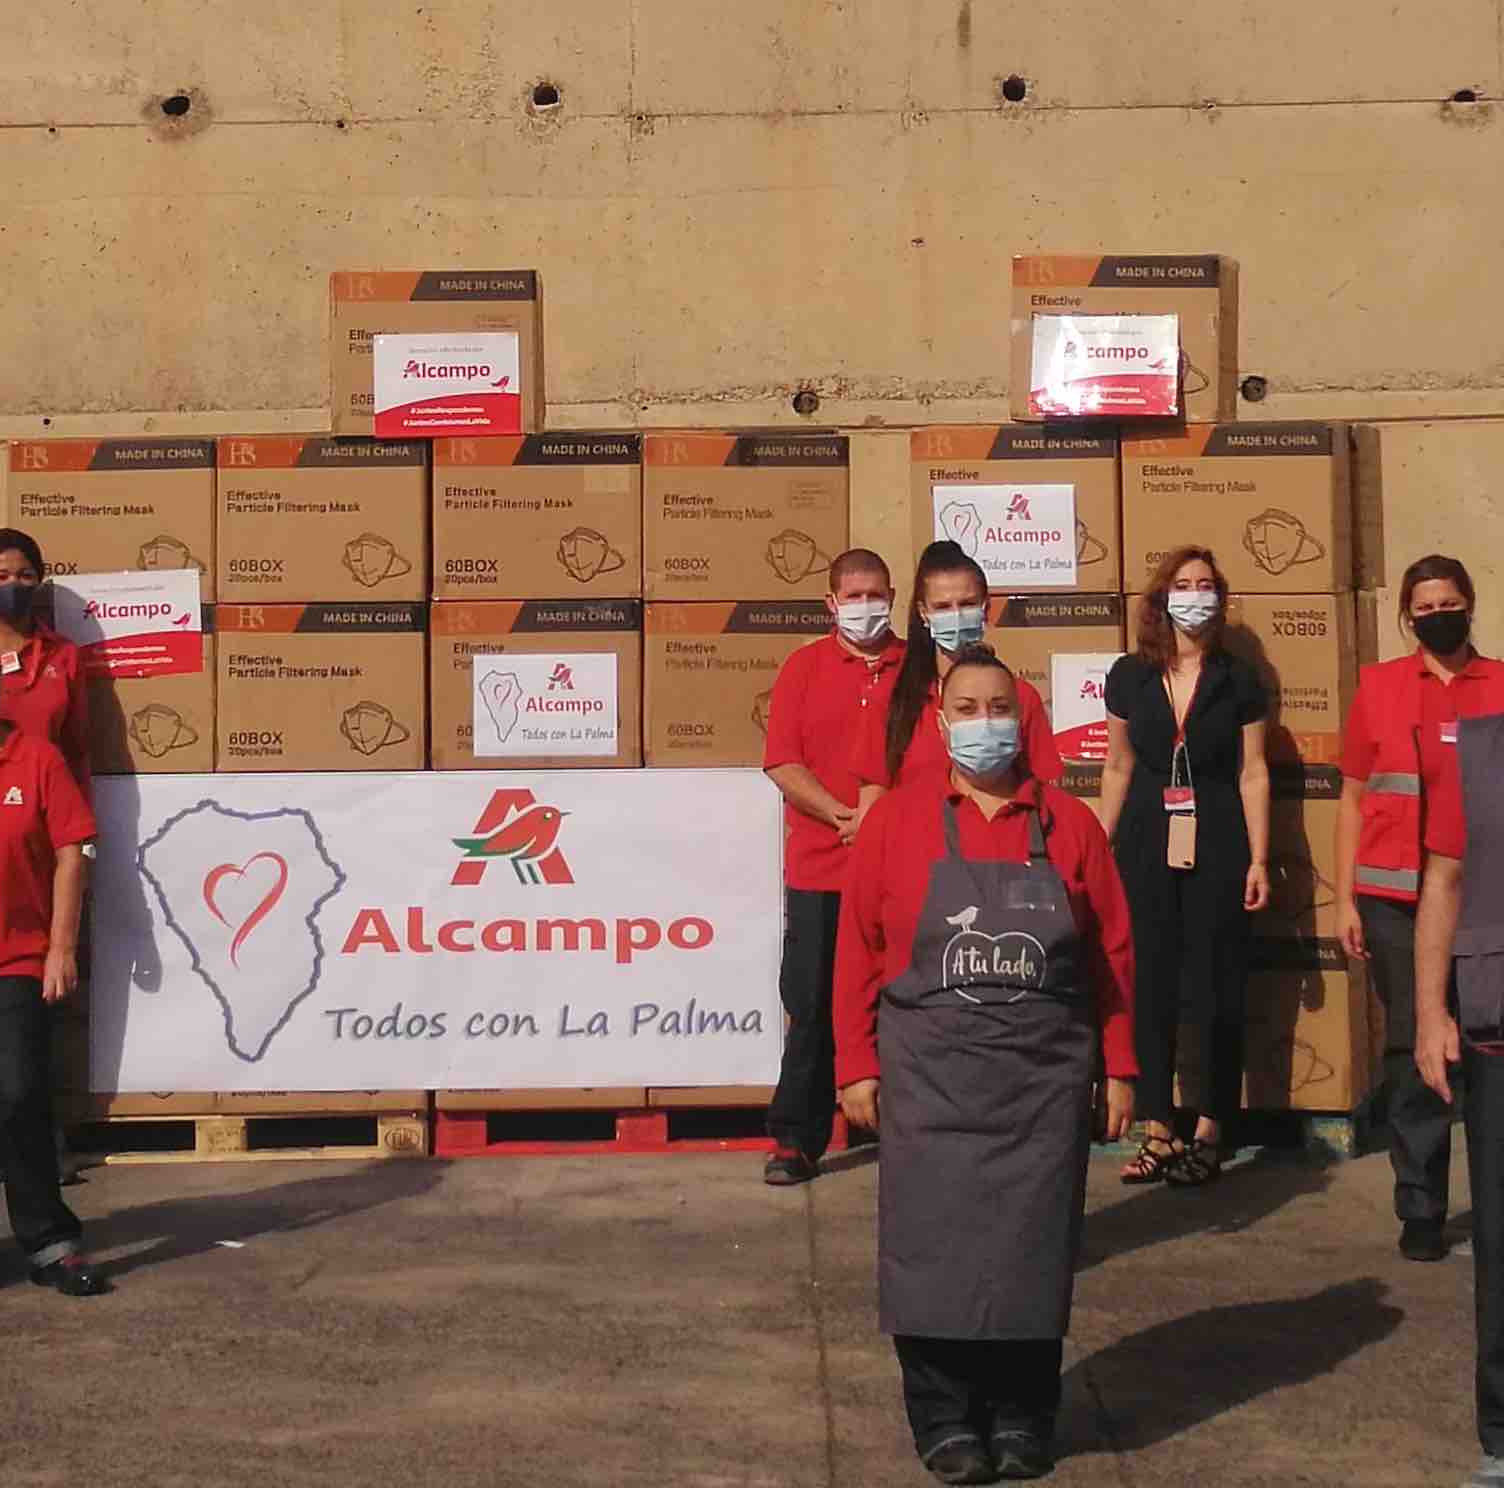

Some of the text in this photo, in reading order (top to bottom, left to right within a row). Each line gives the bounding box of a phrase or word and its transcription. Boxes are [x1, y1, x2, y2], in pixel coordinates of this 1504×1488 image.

[1116, 267, 1205, 277] MADE IN CHINA
[440, 280, 526, 290] MADE IN CHINA
[1031, 295, 1082, 306] Effective
[403, 360, 490, 380] Alcampo
[1012, 439, 1100, 449] MADE IN CHINA
[1228, 435, 1318, 446] MADE IN CHINA
[115, 449, 205, 460] MADE IN CHINA
[321, 446, 409, 457] MADE IN CHINA
[542, 445, 629, 455] MADE IN CHINA
[754, 446, 838, 457] MADE IN CHINA
[929, 469, 979, 480] Effective
[1142, 465, 1193, 477] Effective
[227, 490, 281, 501] Effective
[445, 487, 496, 497] Effective
[20, 493, 75, 504] Effective
[664, 494, 714, 505] Effective
[20, 504, 154, 517] Particle Filtering Mask
[227, 502, 360, 513] Particle Filtering Mask
[445, 499, 573, 511] Particle Filtering Mask
[985, 527, 1061, 546] Alcampo
[229, 560, 284, 572] 60BOX
[445, 560, 498, 573] 60BOX
[664, 558, 710, 570] 60BOX
[982, 558, 1072, 570] Todos con La Palma
[83, 600, 172, 619] Alcampo
[1026, 606, 1110, 617] MADE IN CHINA
[323, 613, 412, 623] MADE IN CHINA
[537, 611, 625, 622] MADE IN CHINA
[750, 614, 837, 624] MADE IN CHINA
[1272, 623, 1328, 636] 60BOX
[454, 643, 504, 654] Effective
[666, 642, 717, 653] Effective
[229, 655, 282, 665] Effective
[229, 666, 363, 679] Particle Filtering Mask
[525, 697, 603, 715] Alcampo
[522, 727, 614, 740] Todos con La Palma
[667, 725, 714, 736] 60BOX
[229, 732, 283, 745] 60BOX
[341, 906, 714, 964] Alcampo
[952, 948, 964, 976] A
[964, 946, 988, 974] tu
[325, 998, 763, 1039] Todos con La Palma
